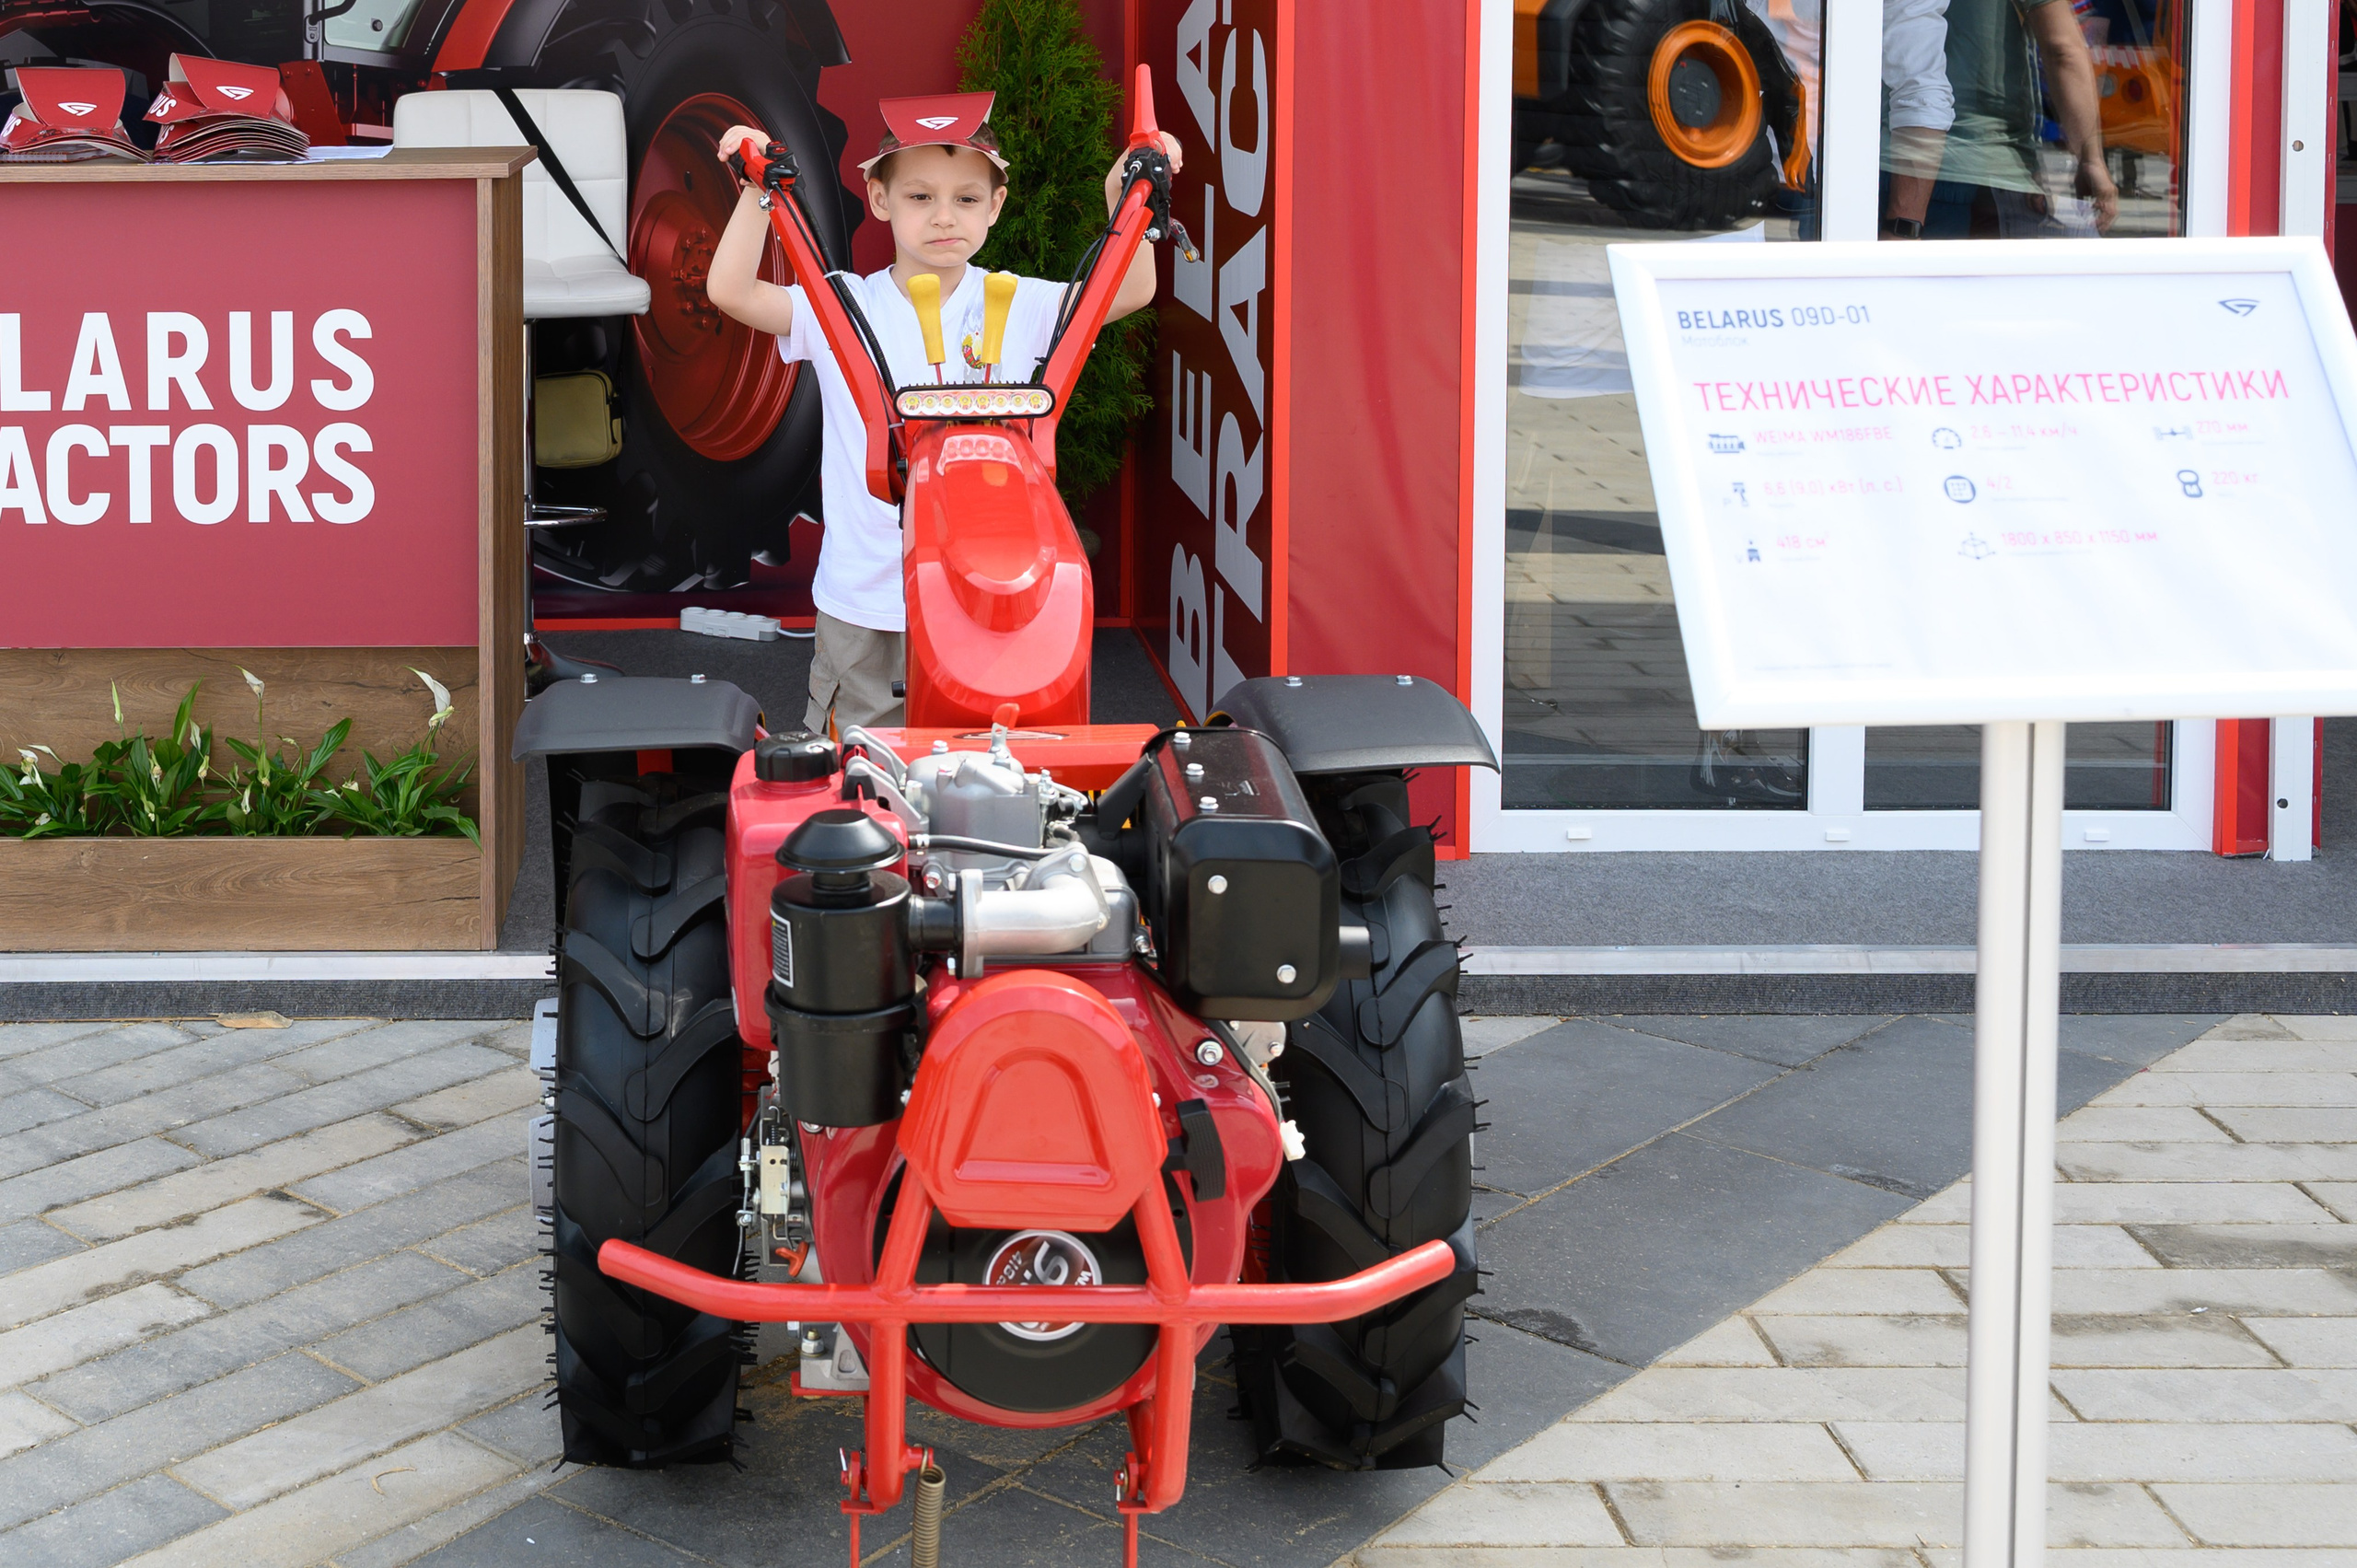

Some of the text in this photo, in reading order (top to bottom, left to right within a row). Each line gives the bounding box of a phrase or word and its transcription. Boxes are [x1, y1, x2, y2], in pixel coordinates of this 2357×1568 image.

[1678, 305, 1871, 330] BELARUS 09D-01
[0, 308, 375, 412] LARUS
[1692, 369, 2290, 412] ТЕХНИЧЕСКИЕ ХАРАКТЕРИСТИКИ
[2038, 422, 2078, 438] км/ч
[2195, 420, 2248, 434] 270 мм
[1753, 430, 1806, 444] WEIMA
[0, 423, 376, 525] ACTORS
[1987, 473, 2014, 490] 4/2
[2212, 470, 2238, 485] 220
[1777, 534, 1802, 551] 418
[2001, 531, 2037, 546] 1800
[2053, 529, 2083, 545] 850
[2097, 528, 2131, 544] 1150
[2134, 530, 2158, 542] мм
